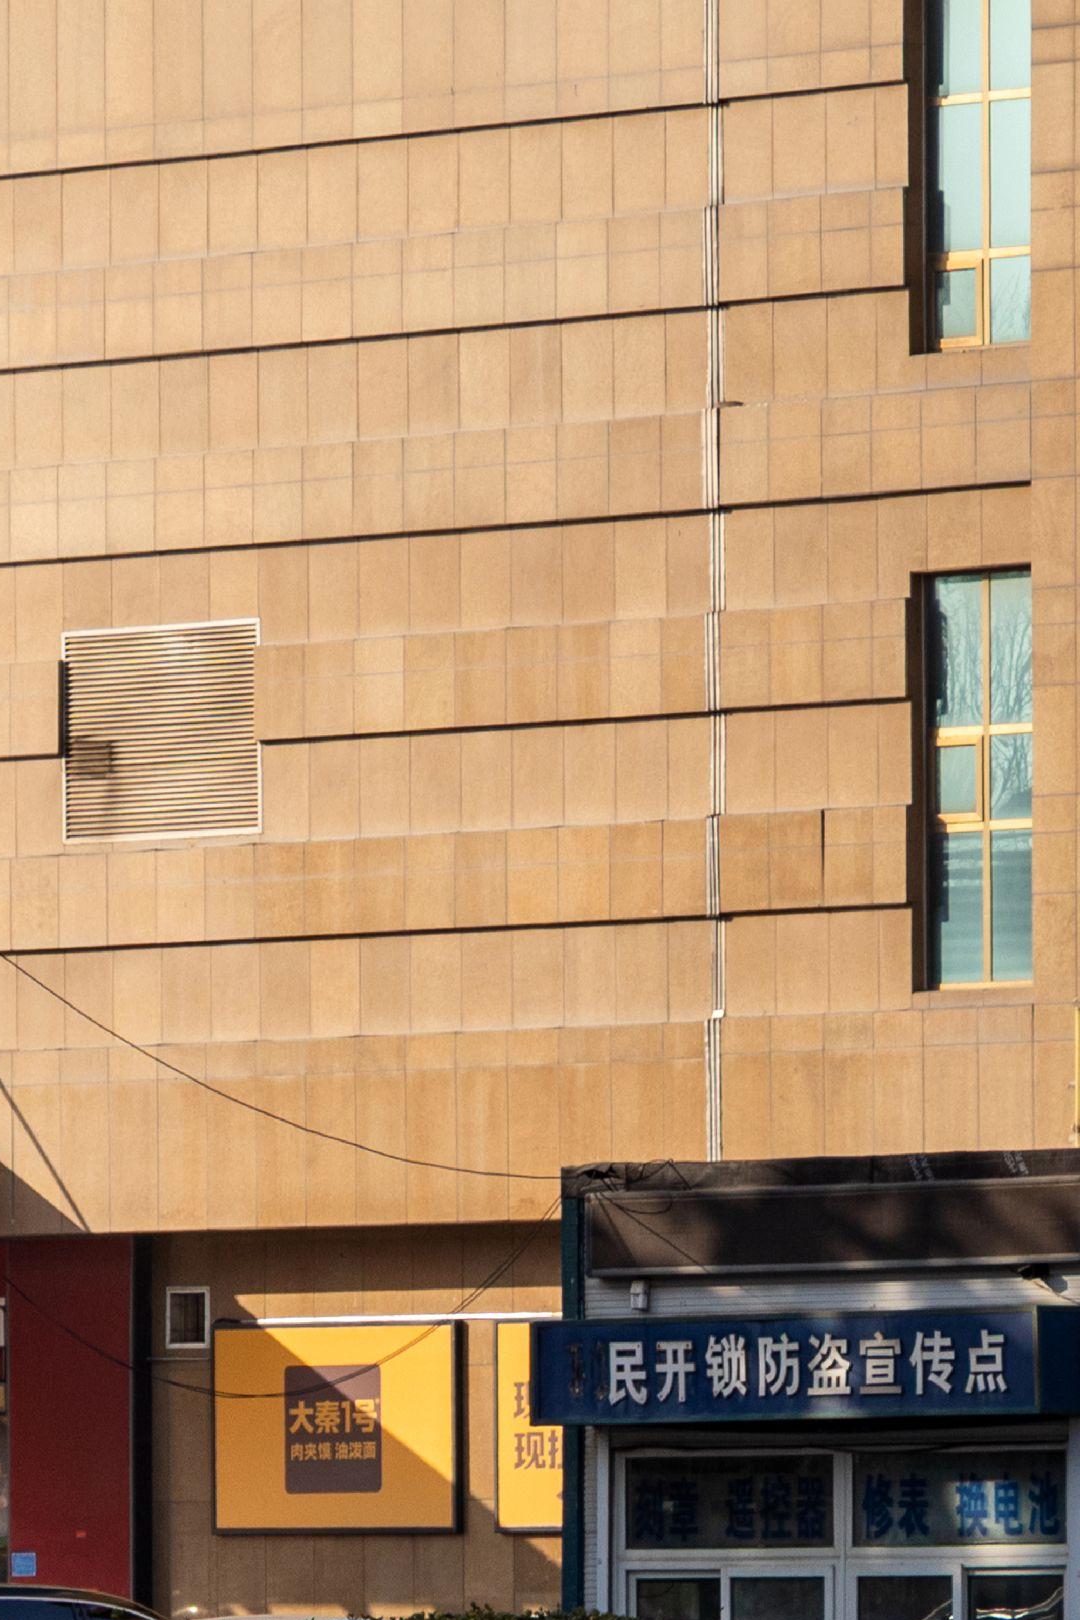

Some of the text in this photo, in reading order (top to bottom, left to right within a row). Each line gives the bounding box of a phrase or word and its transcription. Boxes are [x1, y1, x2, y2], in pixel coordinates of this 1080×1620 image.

[608, 1329, 1008, 1406] 民开锁防盗宣传点
[289, 1398, 378, 1434] 大秦1号
[290, 1442, 332, 1461] 肉夹馍
[862, 1473, 930, 1541] 修表
[955, 1470, 1061, 1538] 换电池
